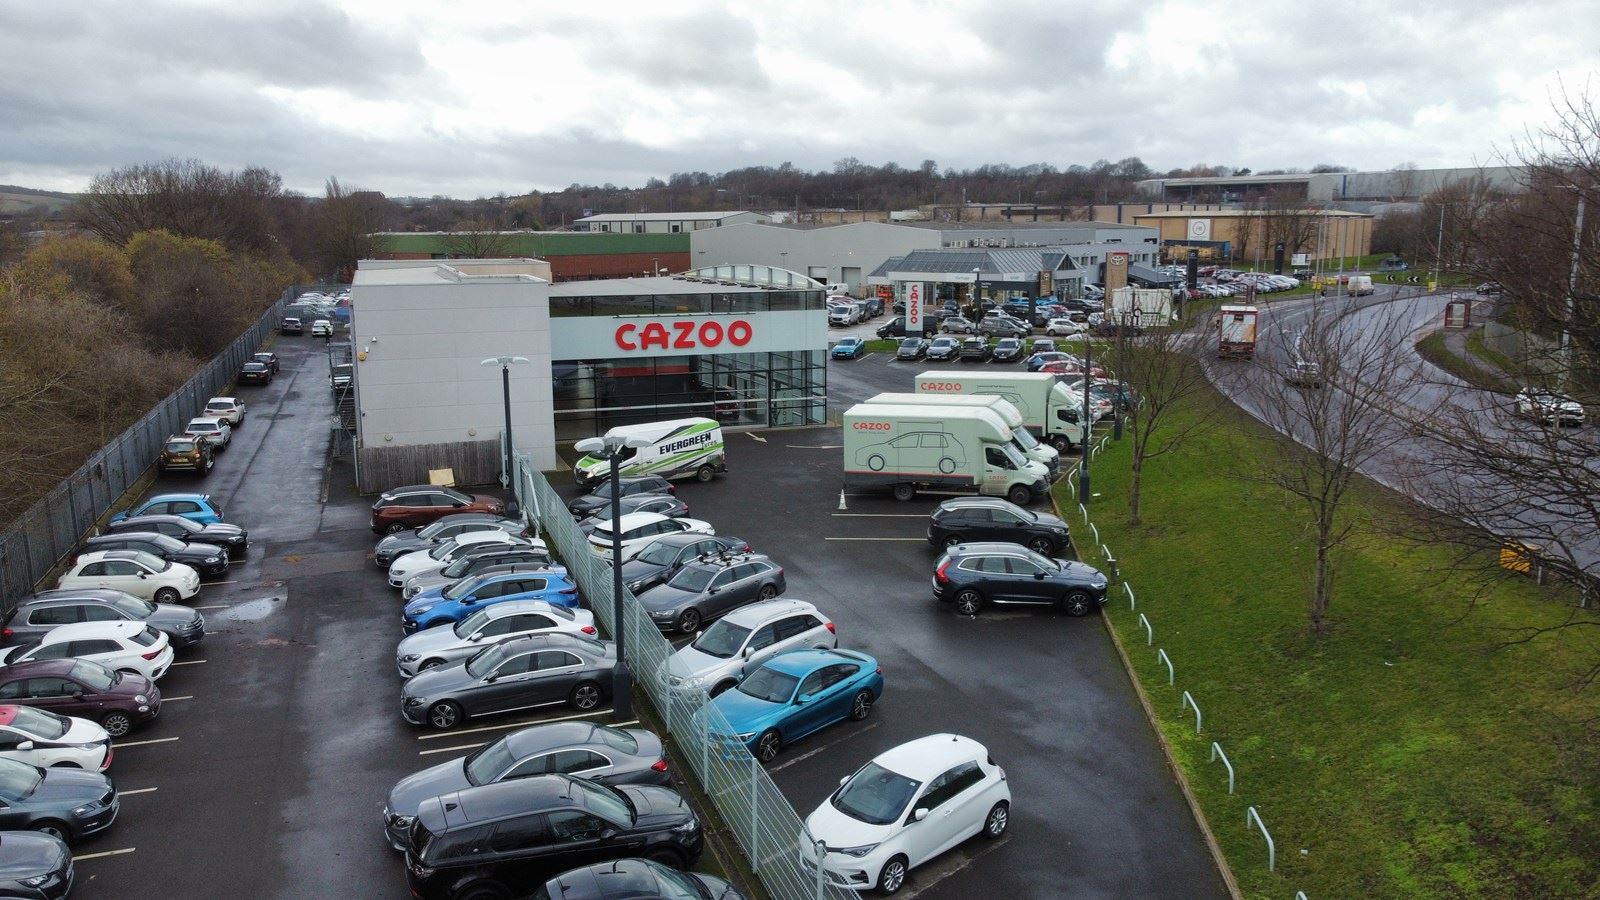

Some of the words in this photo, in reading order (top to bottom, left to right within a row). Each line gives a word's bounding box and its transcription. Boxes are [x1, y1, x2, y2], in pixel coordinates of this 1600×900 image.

[910, 284, 918, 324] CAZOO
[615, 320, 753, 350] CAZOO
[920, 382, 962, 391] CAZOO
[852, 422, 891, 431] CAZOO
[659, 432, 711, 455] EVERGREEN
